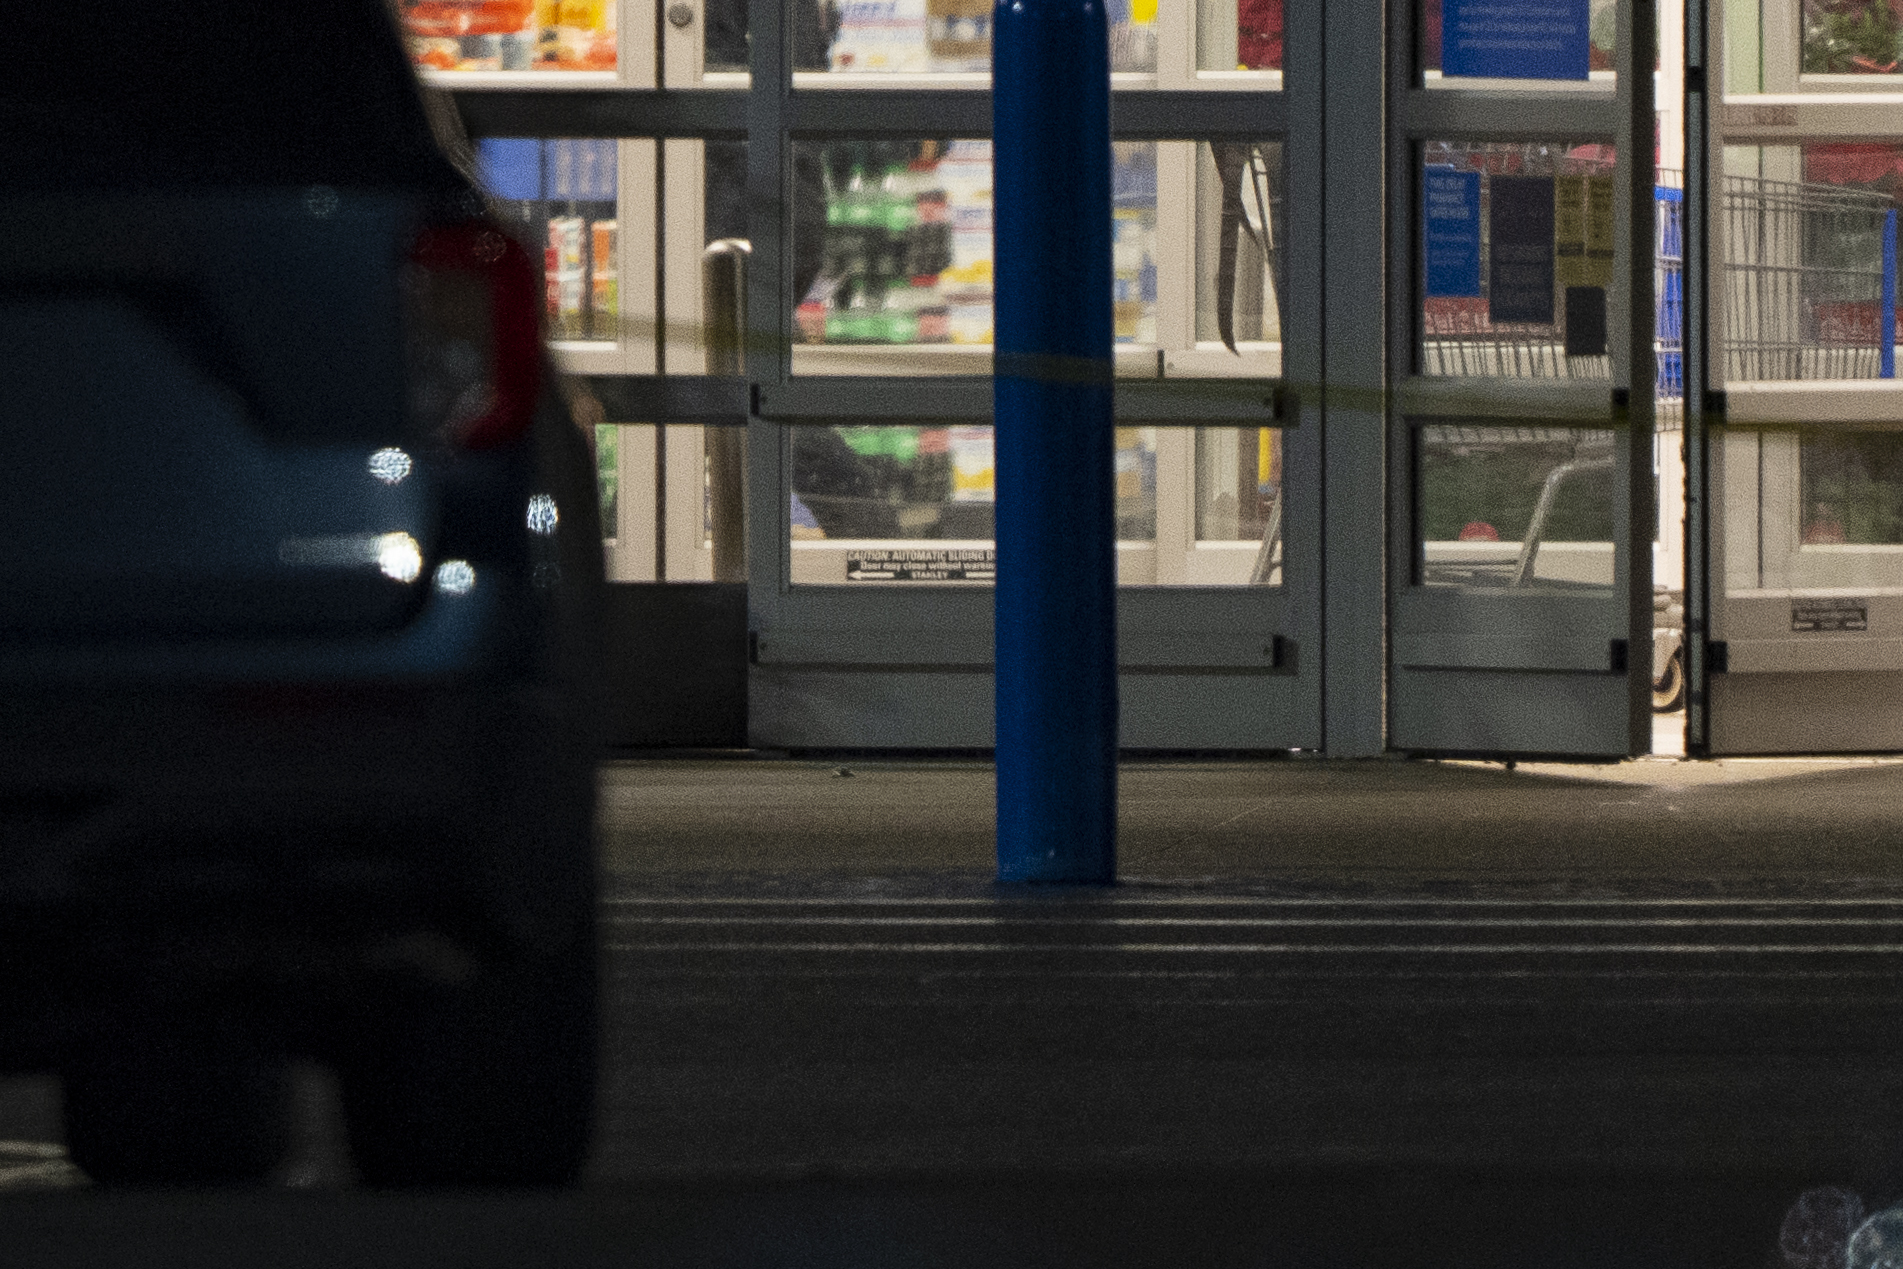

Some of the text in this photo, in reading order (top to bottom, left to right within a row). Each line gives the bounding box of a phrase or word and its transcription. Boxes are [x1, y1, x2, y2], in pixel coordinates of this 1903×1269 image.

[892, 550, 947, 561] AUTOMATIC
[861, 561, 881, 570] Door
[883, 562, 901, 572] may
[928, 561, 961, 570] without
[912, 571, 948, 579] STANLEY
